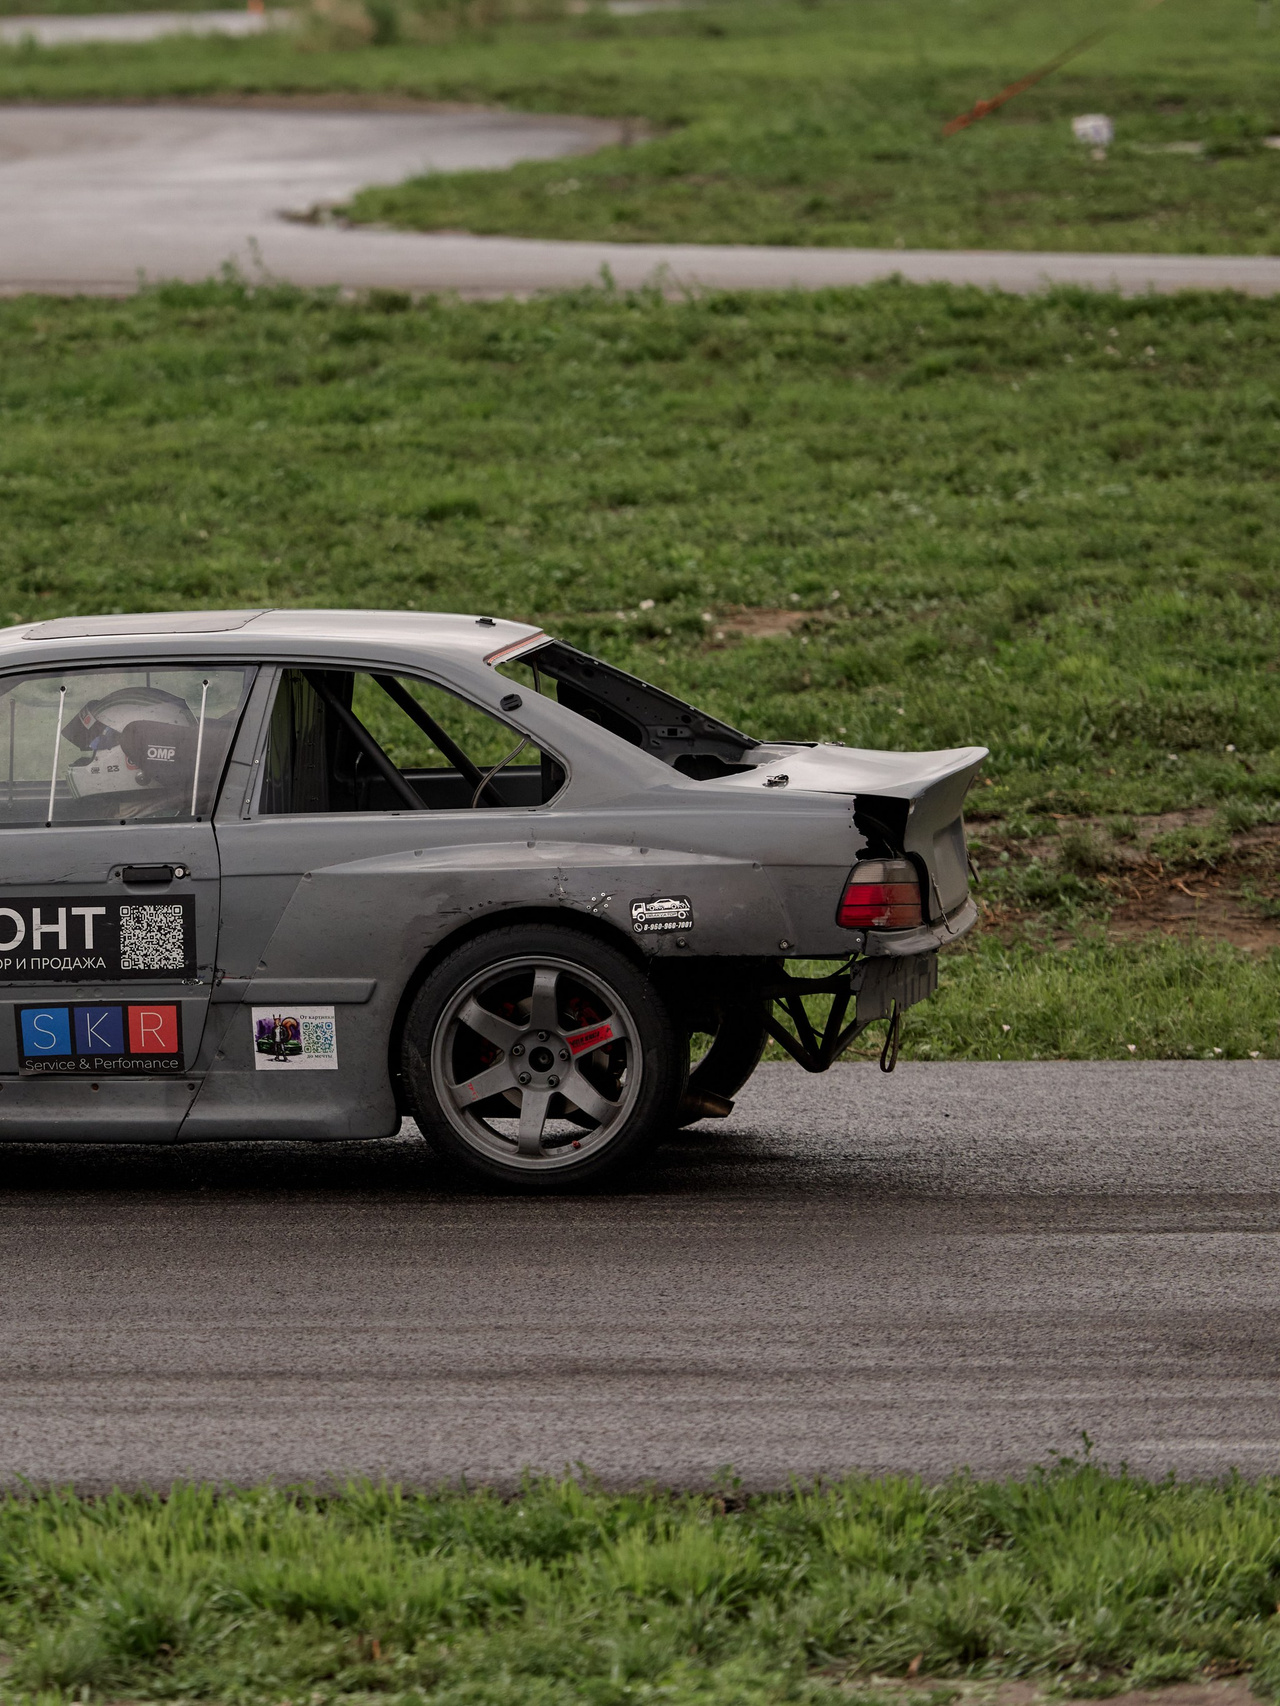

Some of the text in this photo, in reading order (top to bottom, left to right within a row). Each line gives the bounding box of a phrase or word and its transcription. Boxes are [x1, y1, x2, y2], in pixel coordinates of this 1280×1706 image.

[147, 748, 176, 759] OMP
[107, 765, 120, 773] 23
[16, 957, 27, 970] И
[31, 956, 107, 971] ПРОДАЖА
[25, 1057, 179, 1071] Service & Perfomance
